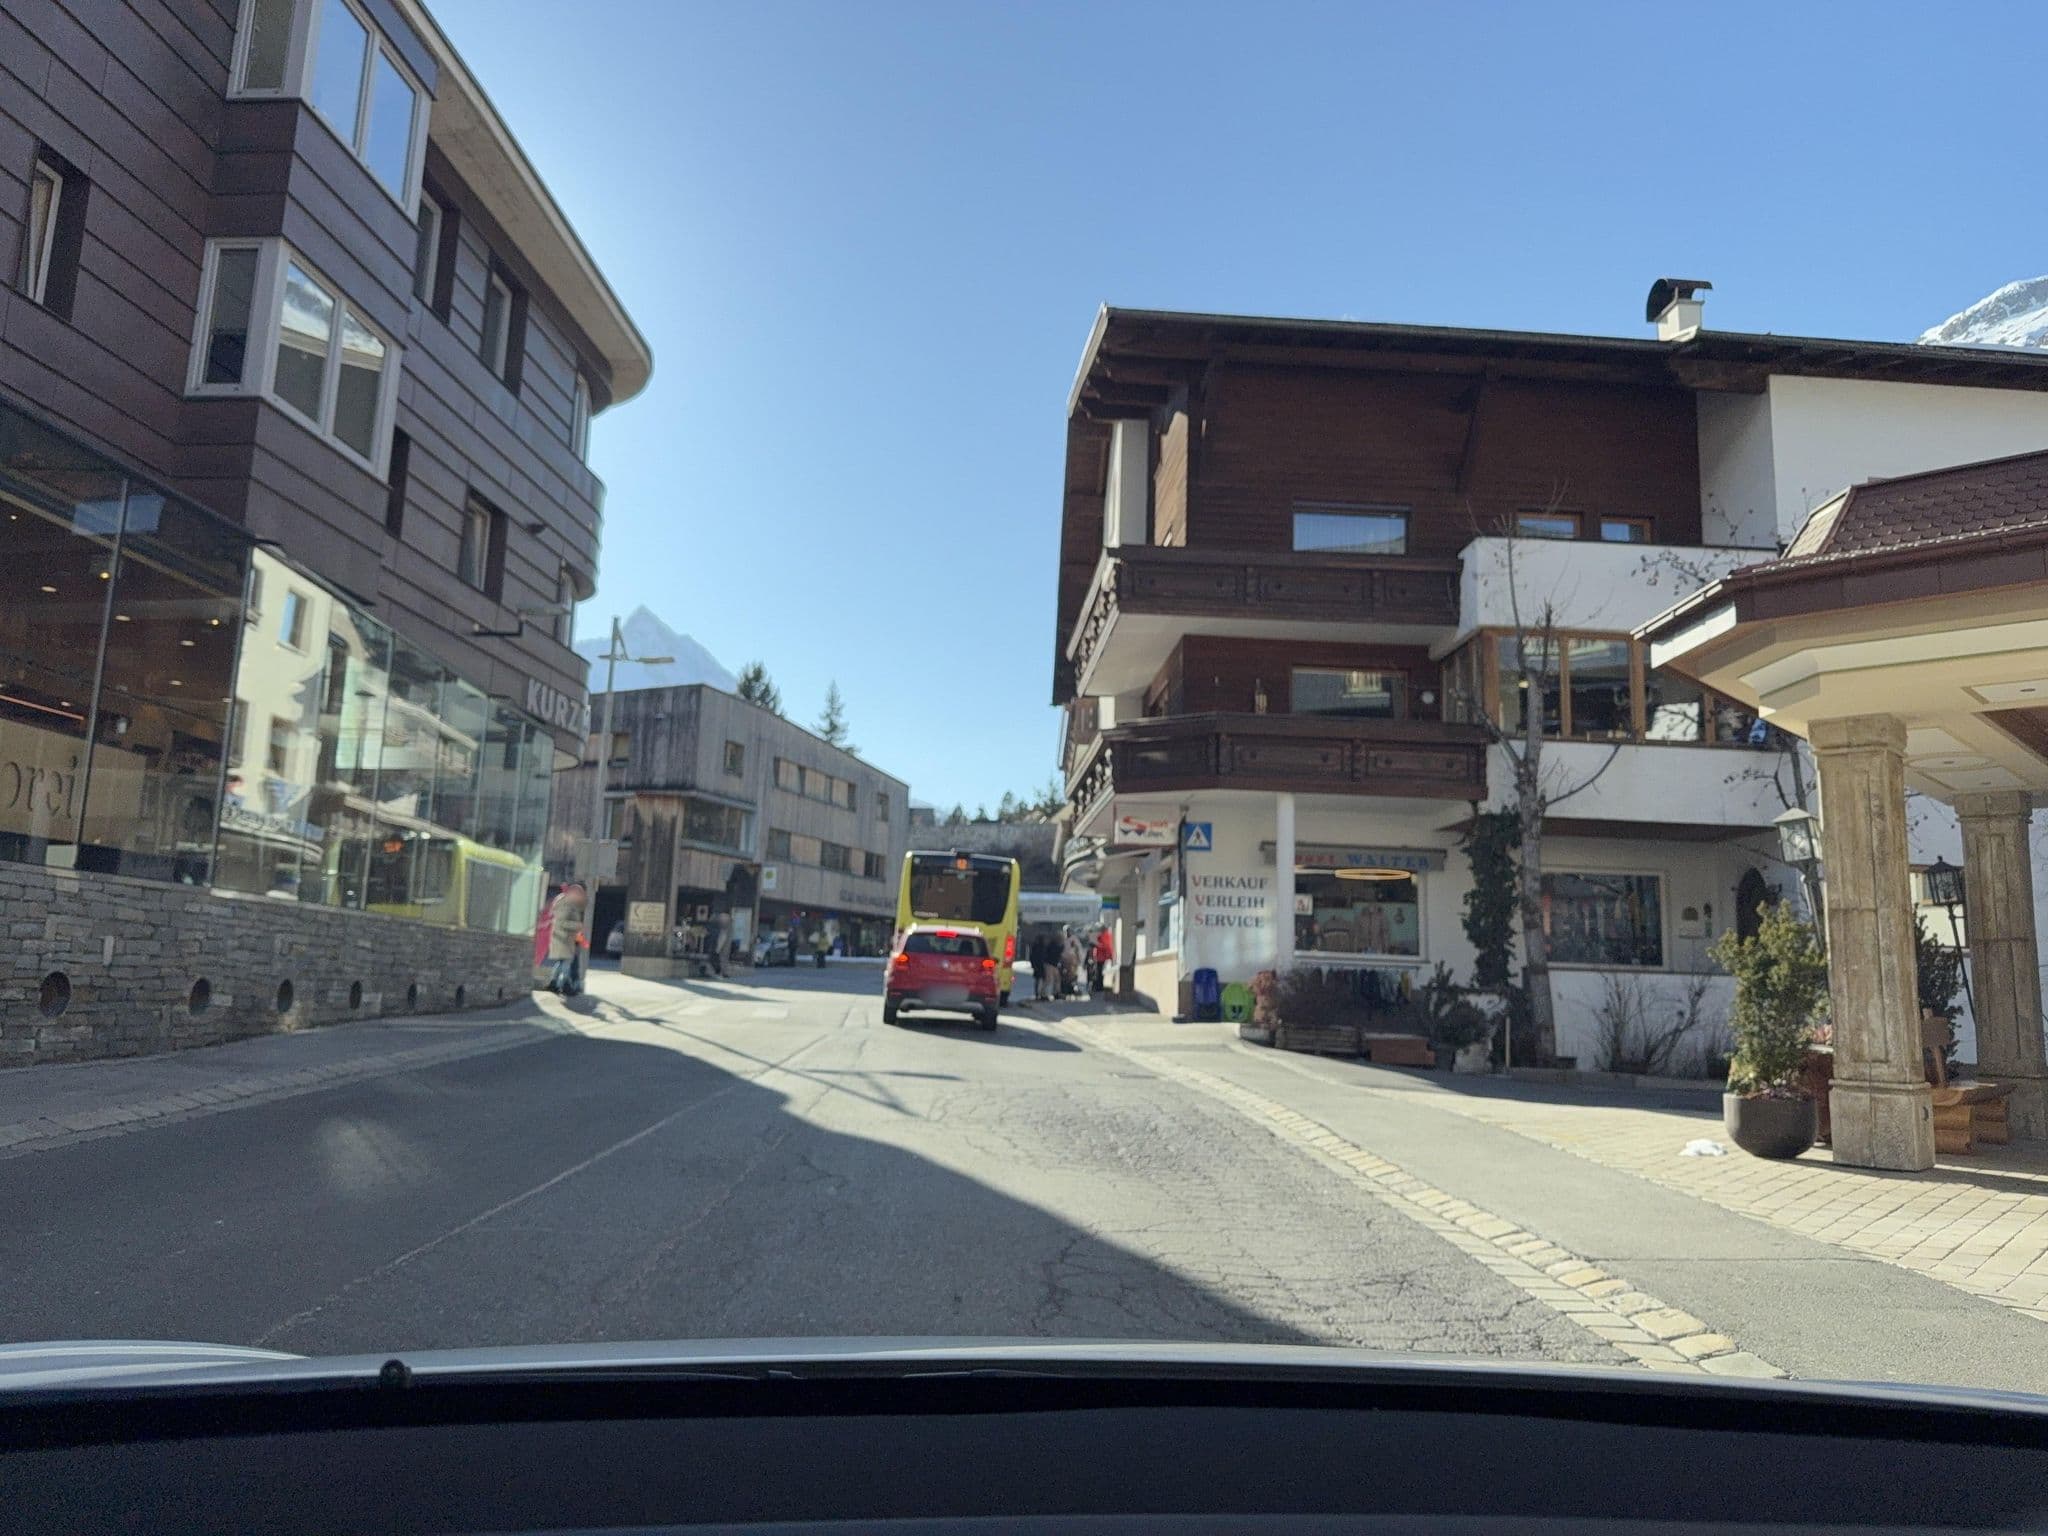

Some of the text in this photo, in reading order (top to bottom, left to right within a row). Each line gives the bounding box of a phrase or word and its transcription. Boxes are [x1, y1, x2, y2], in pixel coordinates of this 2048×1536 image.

[527, 678, 581, 734] KURZ
[1346, 854, 1429, 868] WALTER
[1191, 873, 1269, 889] VERKAUF
[1194, 894, 1264, 908] VERLEIH
[1194, 913, 1264, 928] SERVICE
